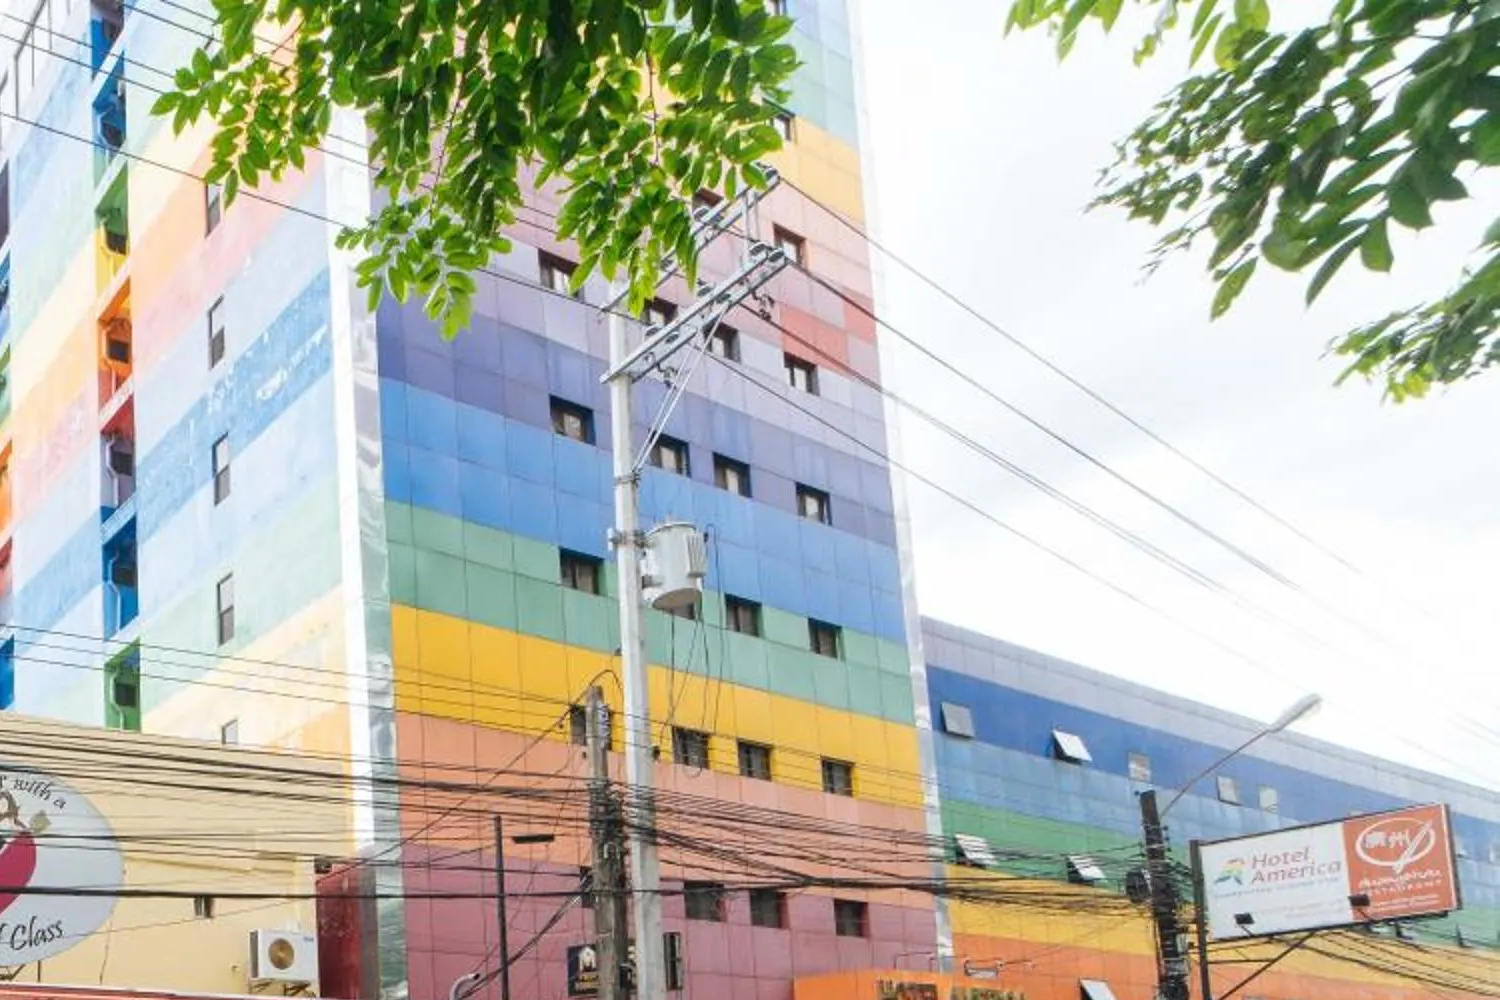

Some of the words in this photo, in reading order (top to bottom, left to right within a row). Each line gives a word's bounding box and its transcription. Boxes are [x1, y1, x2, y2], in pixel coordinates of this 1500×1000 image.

[14, 778, 51, 800] with
[53, 798, 67, 809] a
[1251, 860, 1342, 884] America
[1252, 847, 1310, 870] Hotel
[10, 915, 64, 951] Class
